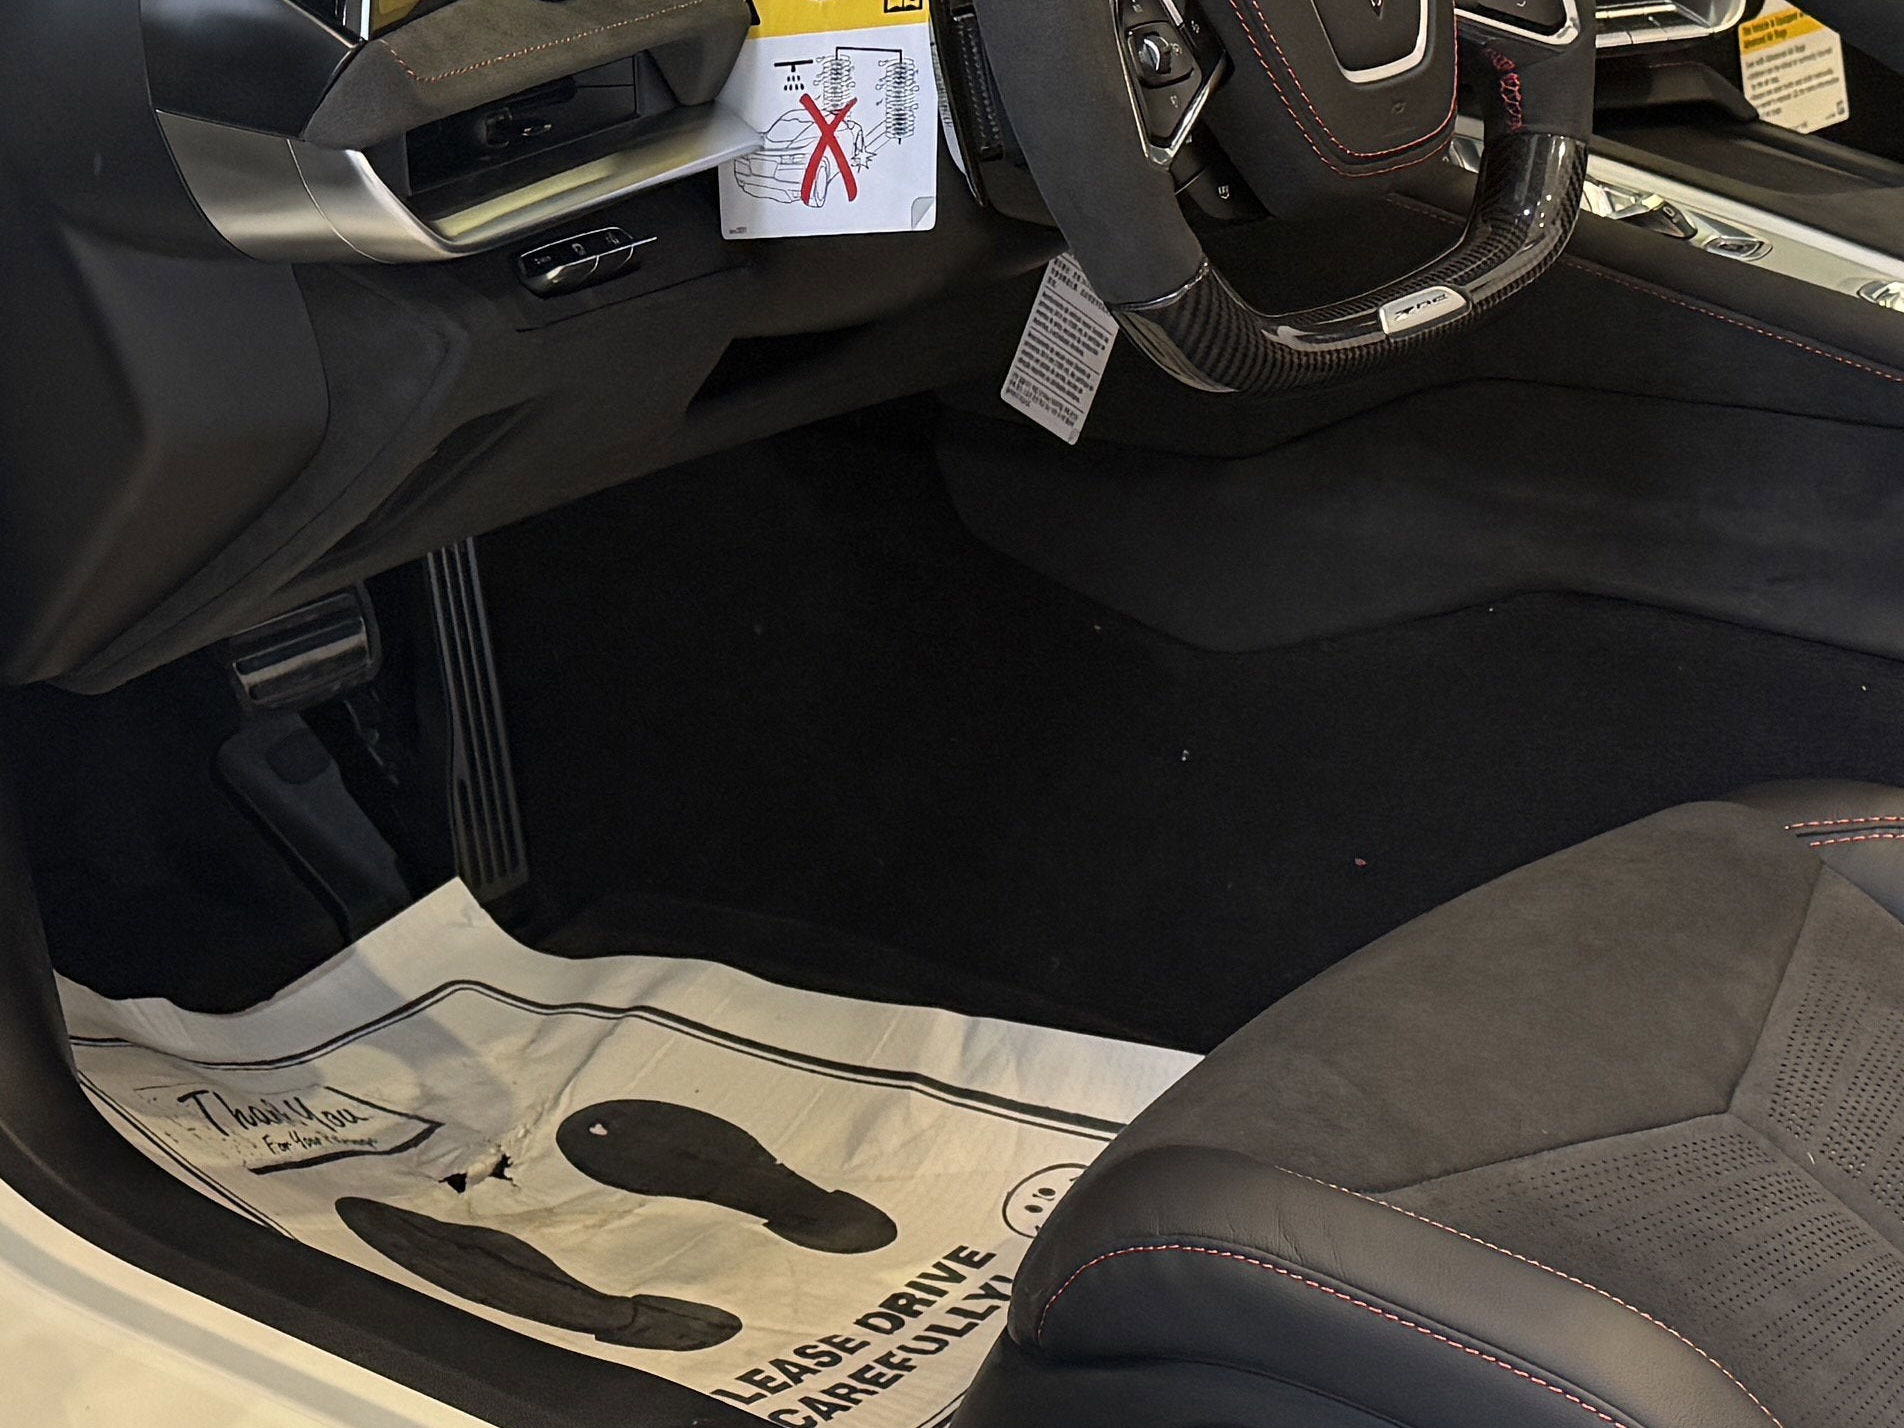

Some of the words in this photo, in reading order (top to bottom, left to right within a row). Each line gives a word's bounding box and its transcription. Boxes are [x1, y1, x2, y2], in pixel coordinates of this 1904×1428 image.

[283, 1097, 372, 1132] You
[711, 1334, 871, 1405] LEASE
[854, 1245, 997, 1335] DRIVE
